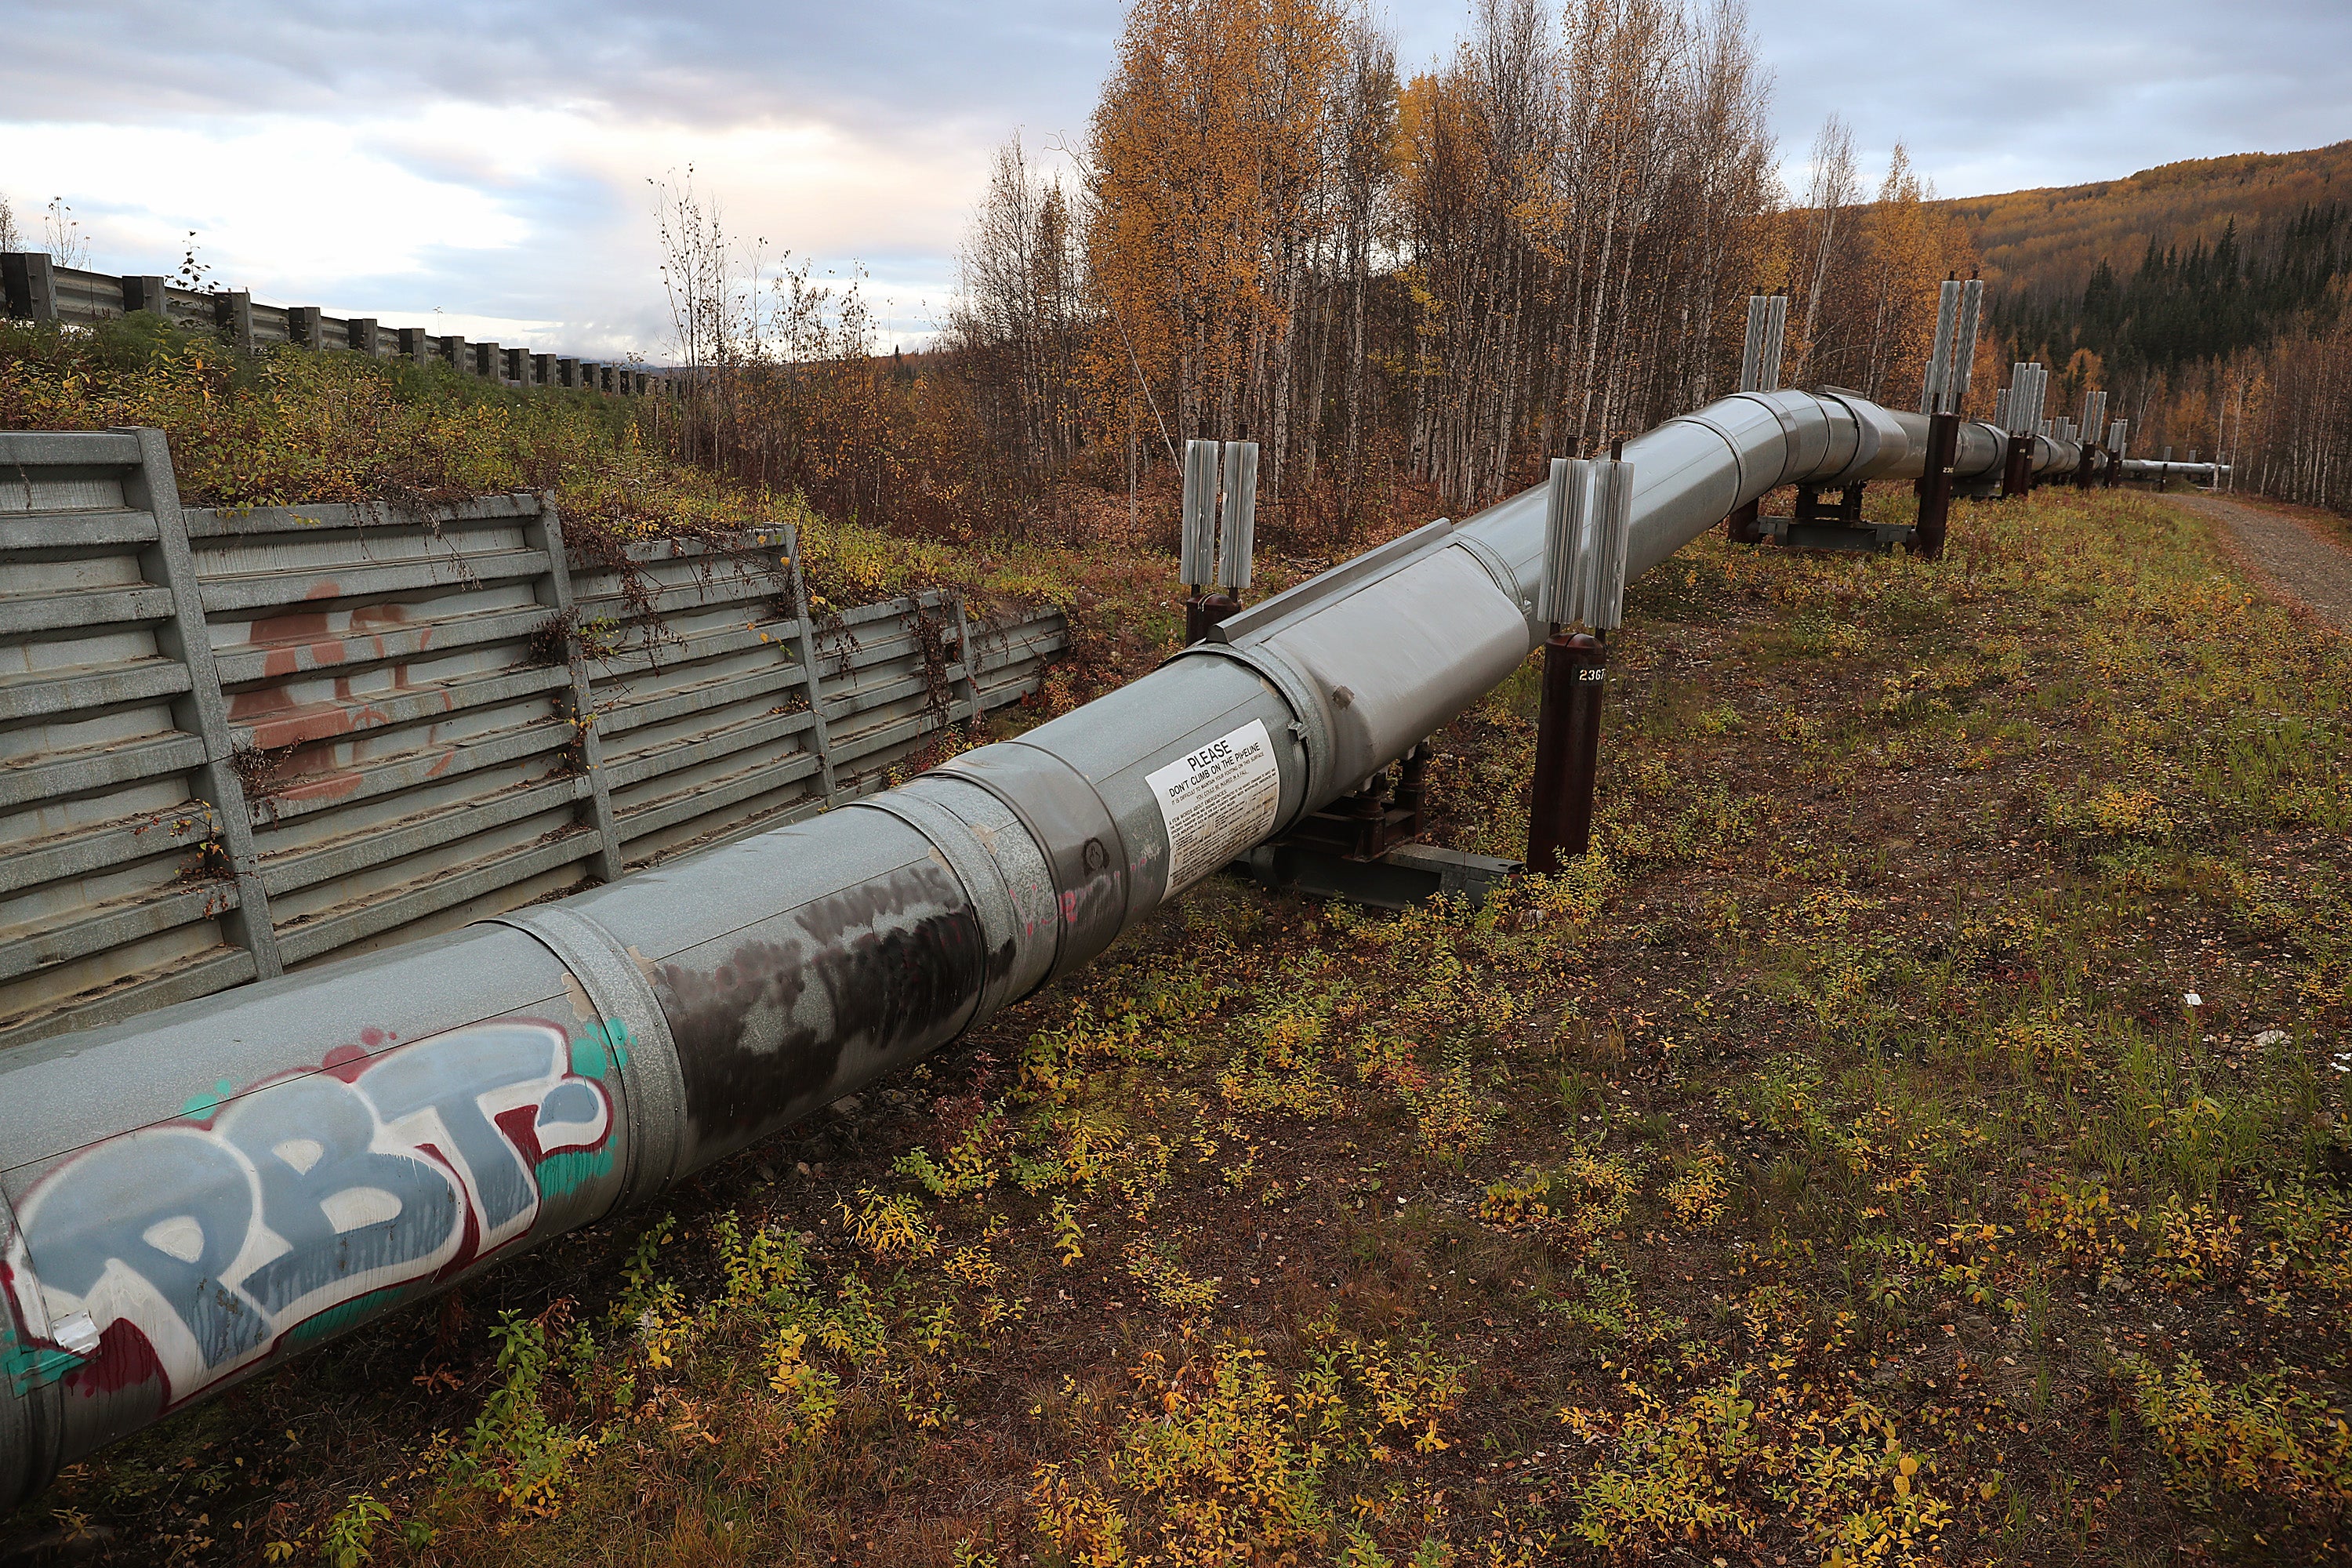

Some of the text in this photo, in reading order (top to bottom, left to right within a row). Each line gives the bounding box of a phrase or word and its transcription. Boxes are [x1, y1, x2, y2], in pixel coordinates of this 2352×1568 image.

[1579, 669, 1606, 681] 2367
[1169, 742, 1260, 797] DON'T CLIMB ON THE PIPELINE
[1188, 740, 1231, 771] PLEASE
